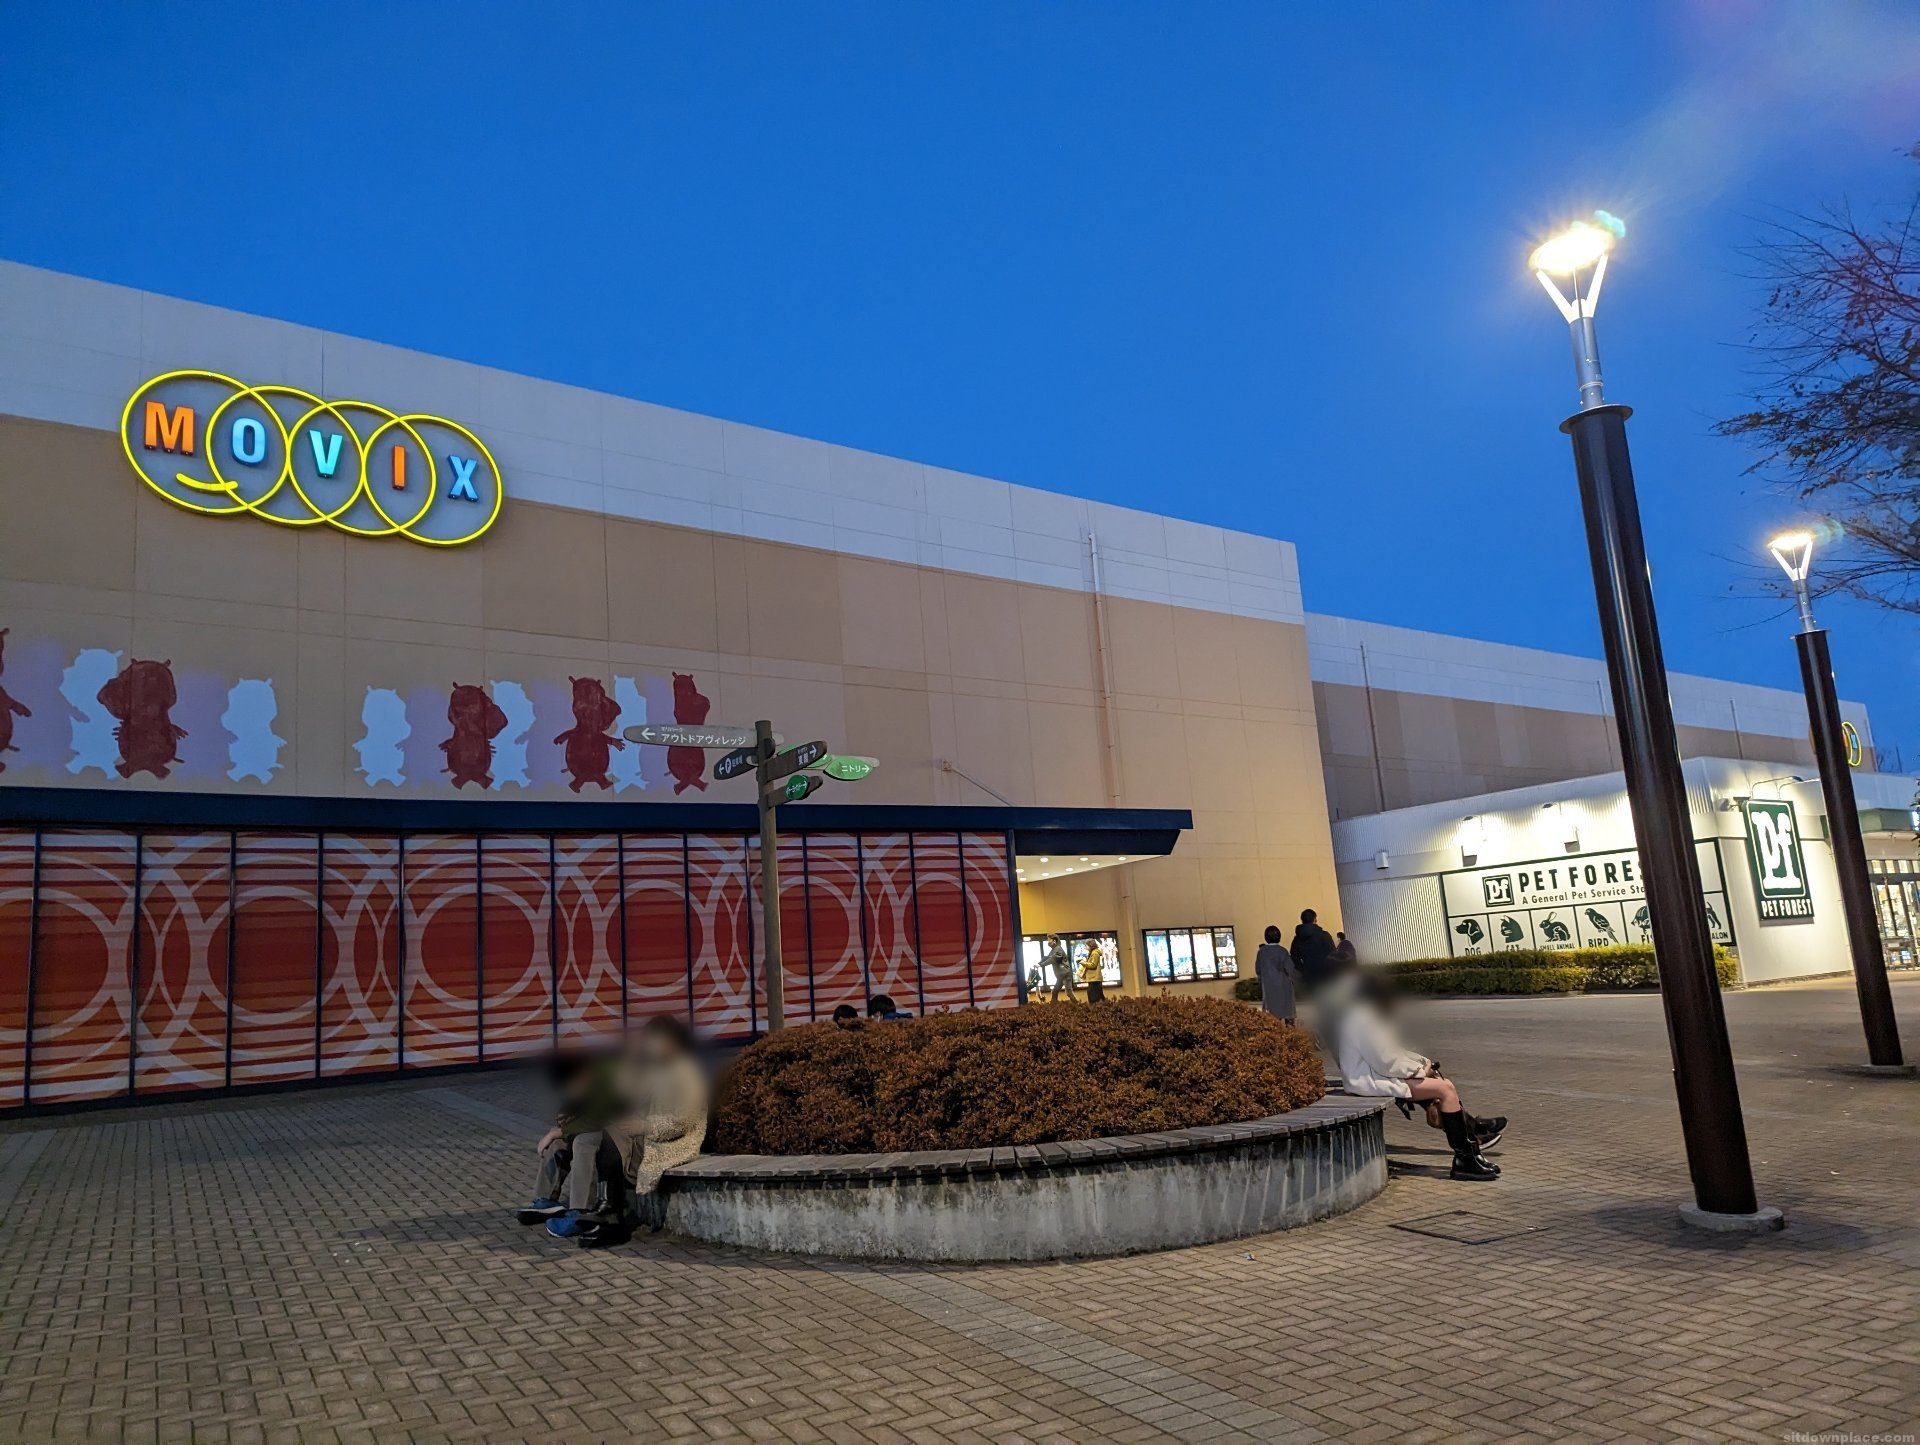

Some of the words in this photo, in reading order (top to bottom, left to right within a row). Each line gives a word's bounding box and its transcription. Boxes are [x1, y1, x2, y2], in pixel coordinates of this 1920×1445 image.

[144, 400, 479, 503] MOVIX
[661, 733, 747, 746] アウトドアヴィレッジ
[841, 764, 861, 773] ニトリ
[1518, 868, 1559, 893] PET
[1568, 860, 1643, 888] FORE
[1522, 896, 1529, 905] A
[1531, 892, 1568, 904] General
[1572, 890, 1587, 900] Pet
[1591, 887, 1626, 899] Service
[1761, 901, 1779, 917] PET
[1780, 898, 1813, 916] FOREST
[1465, 947, 1481, 956] DOG
